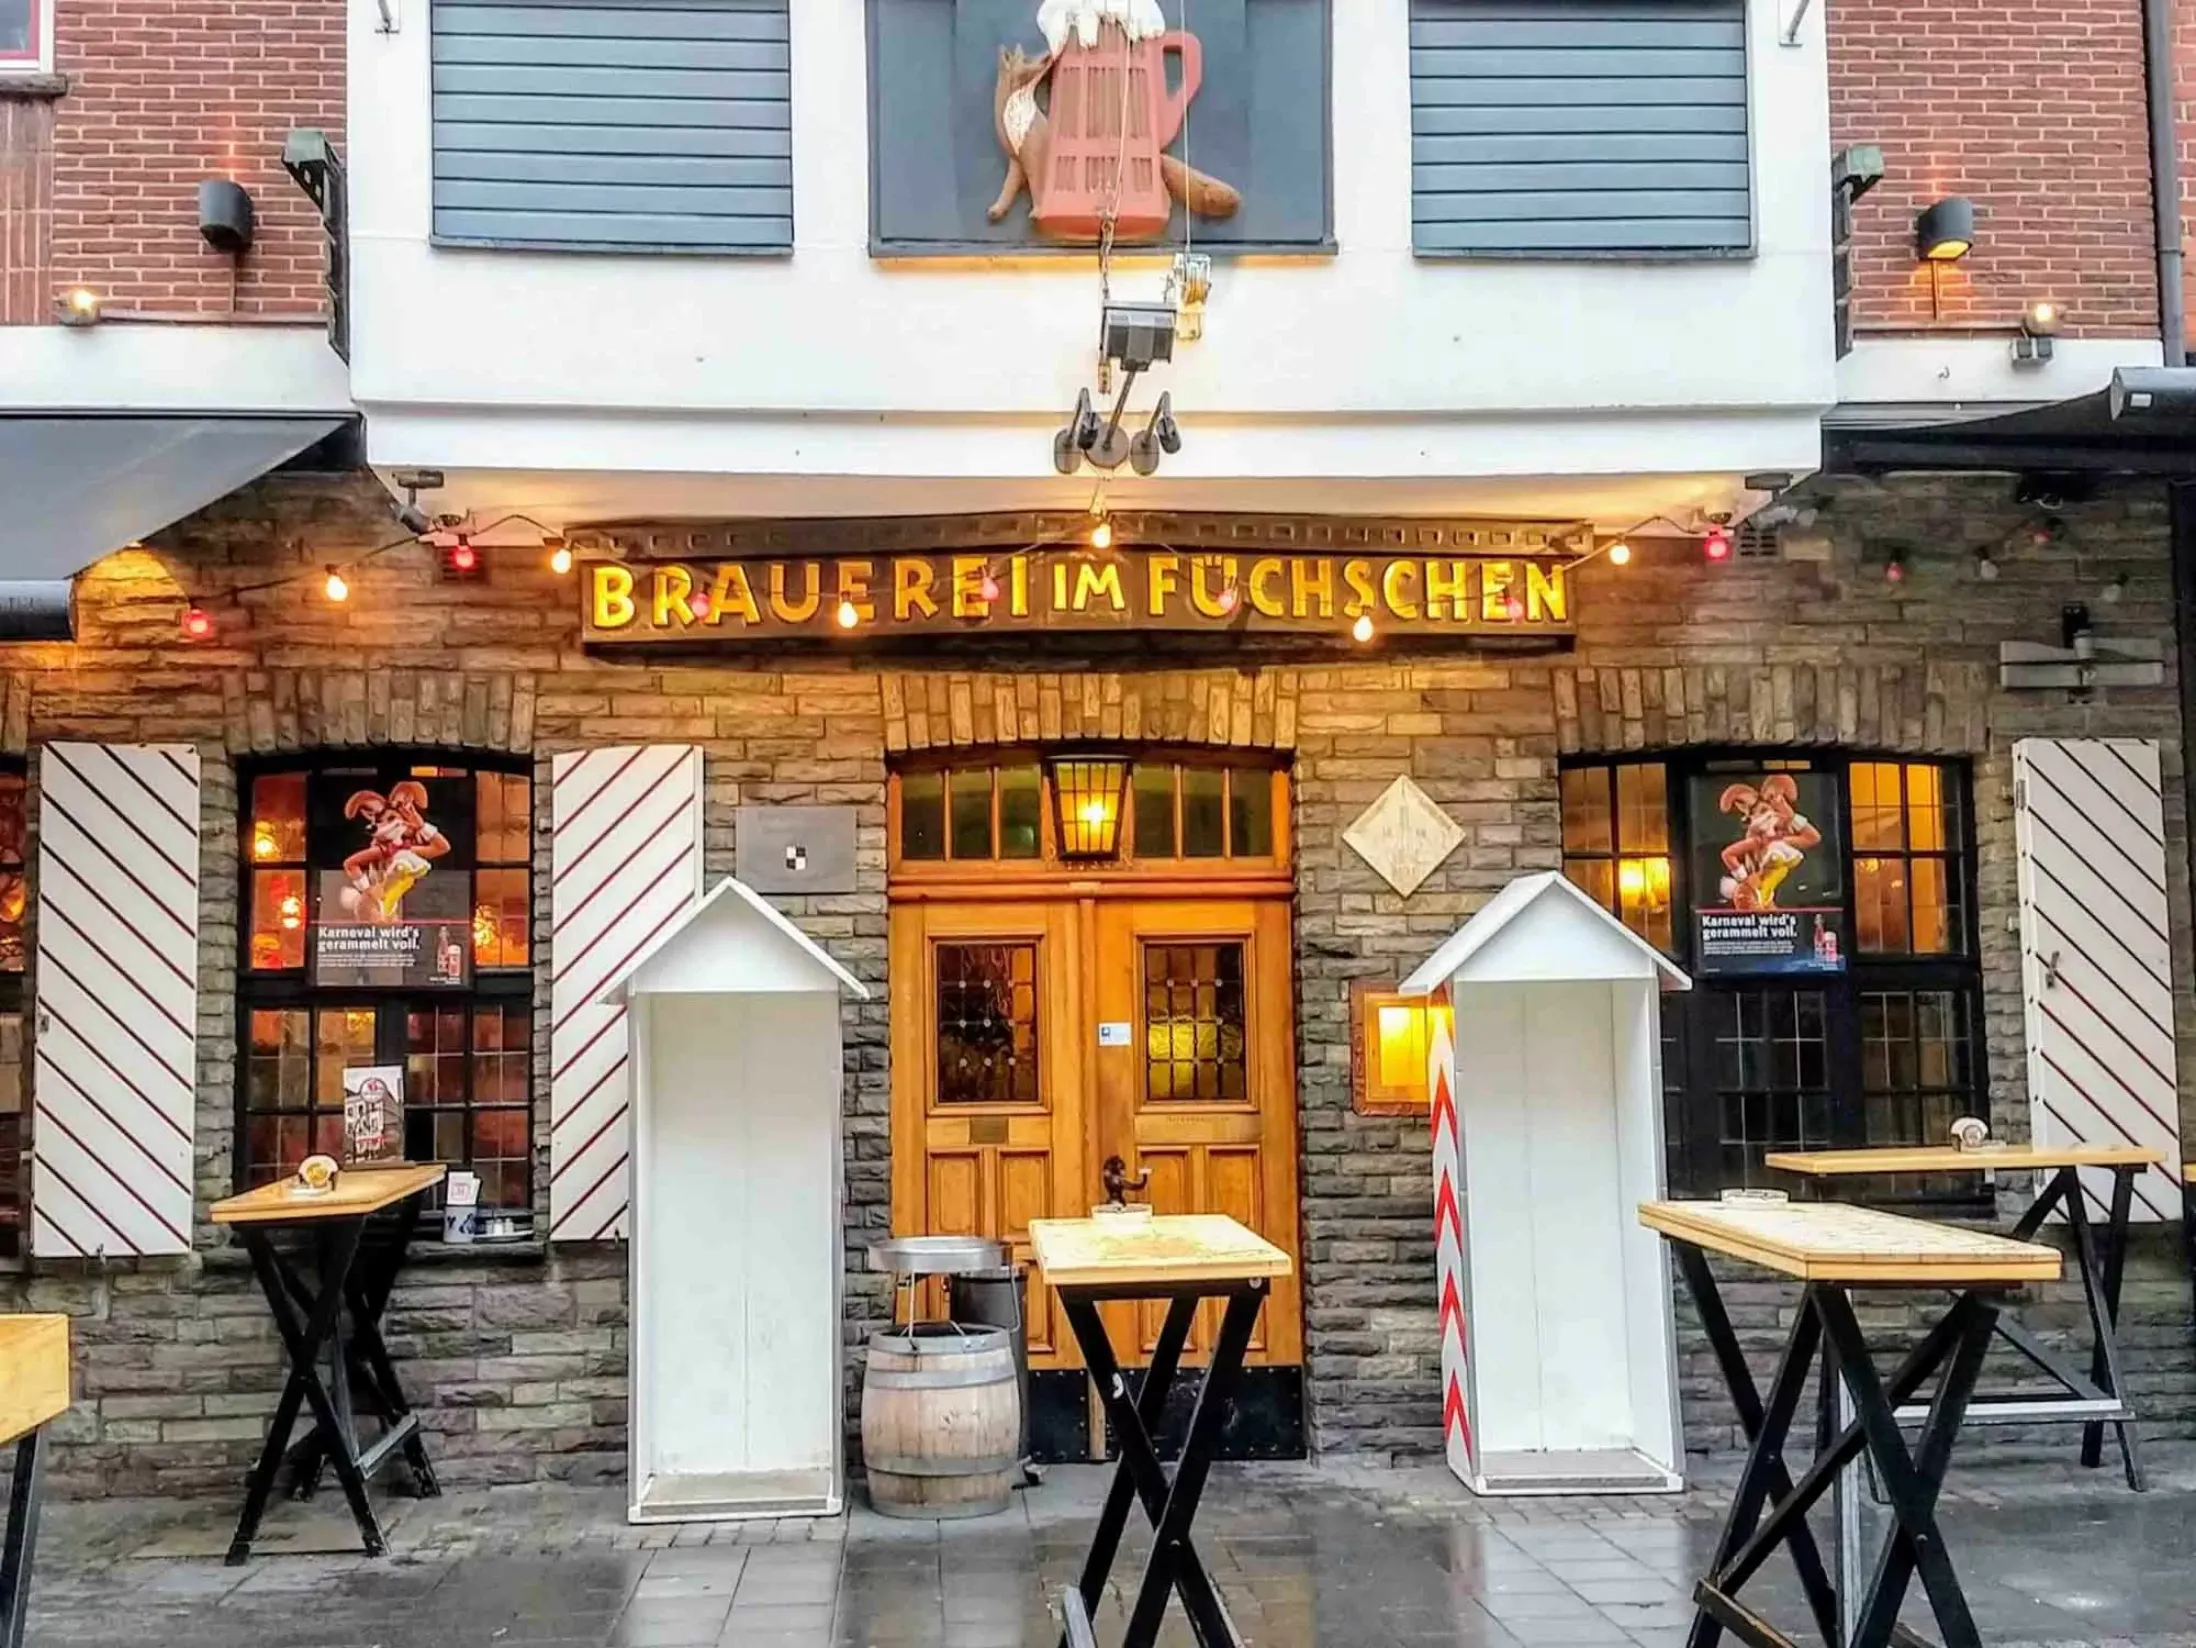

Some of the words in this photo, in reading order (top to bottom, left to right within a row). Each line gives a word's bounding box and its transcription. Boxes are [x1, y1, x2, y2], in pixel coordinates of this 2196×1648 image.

[592, 555, 1029, 629] BRAUEREI
[1053, 562, 1125, 611] IM
[1148, 554, 1569, 622] FÜCHSCHEN
[1702, 914, 1755, 926] Karneval
[1758, 914, 1797, 926] wird's
[318, 926, 376, 938] Karneval
[379, 926, 420, 938] wird's
[1702, 926, 1768, 940] gerammelt
[1771, 926, 1798, 937] voll.
[318, 938, 388, 952] gerammelt
[391, 938, 421, 950] voll.
